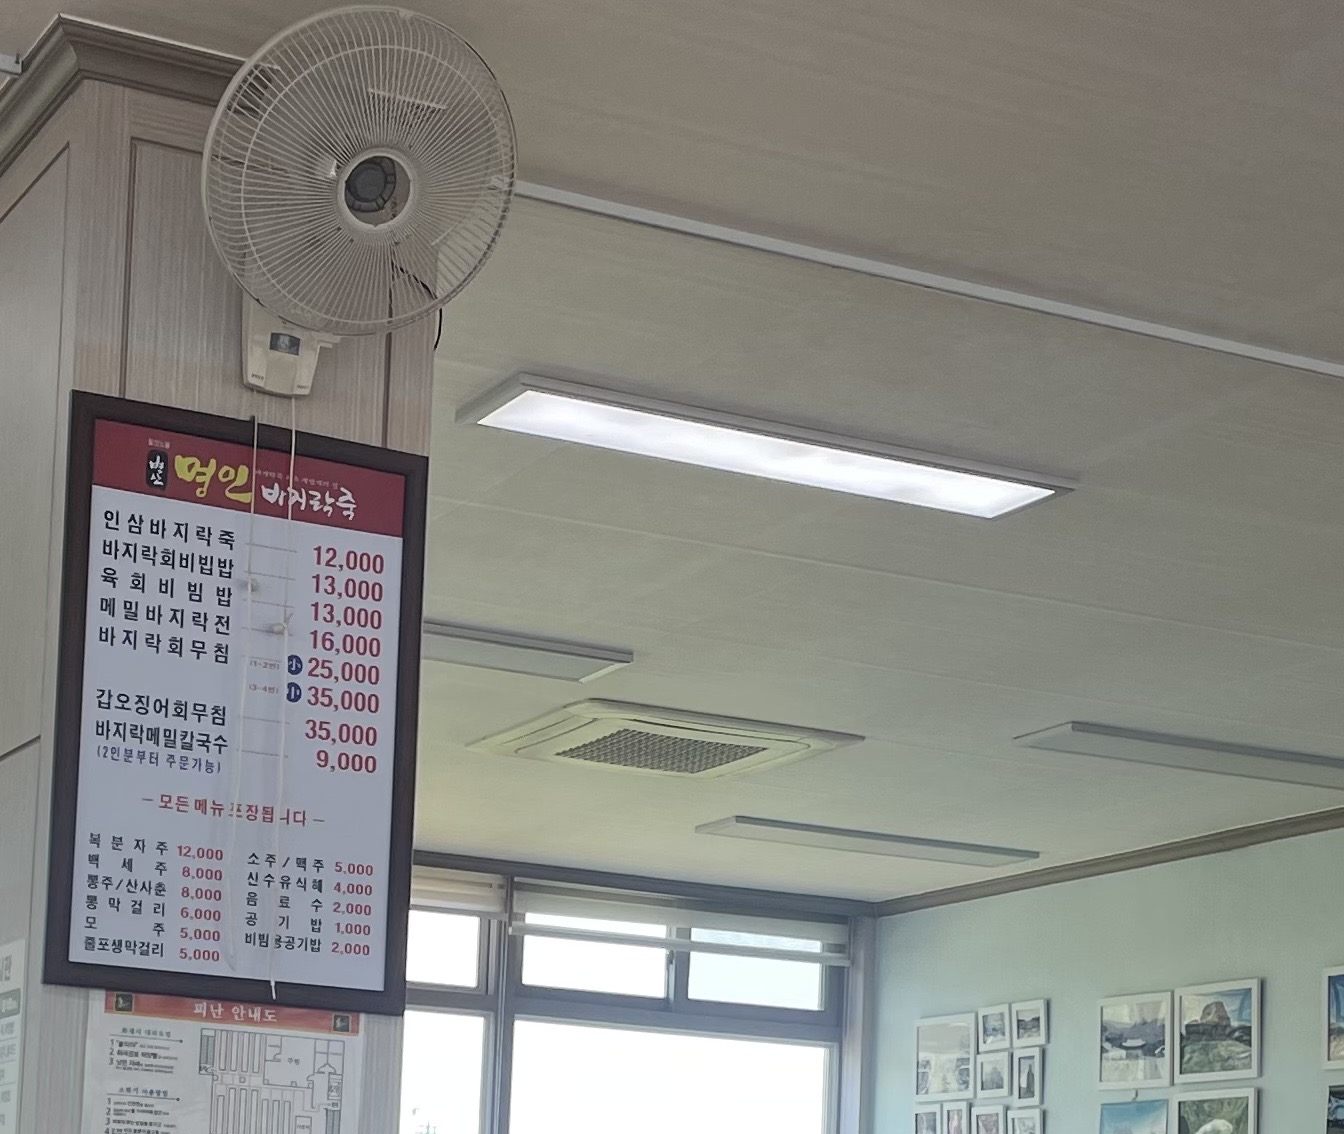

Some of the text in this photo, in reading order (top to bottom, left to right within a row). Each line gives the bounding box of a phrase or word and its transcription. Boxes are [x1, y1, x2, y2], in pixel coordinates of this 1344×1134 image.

[174, 454, 253, 503] 명인
[261, 482, 357, 520] 바지락죽
[104, 510, 235, 550] 인삼바지락죽
[313, 546, 384, 574] 12,000
[101, 567, 232, 607] 육회비빔밥
[312, 574, 383, 602] 13,000
[100, 597, 230, 635] 메밀바지락전
[310, 602, 382, 629] 13,000
[99, 626, 229, 664] 바지락회무침
[309, 630, 381, 658] 16,000
[308, 657, 380, 685] 25,000
[96, 688, 226, 726] 갑오징어회무침
[307, 686, 379, 713] 35,000
[95, 720, 228, 754] 바지락메밀칼국수
[305, 719, 377, 747] 35,000
[316, 750, 377, 773] 9,000
[159, 794, 189, 813] 모든
[194, 798, 224, 817] 메뉴
[89, 832, 168, 856] 복분자주
[177, 845, 223, 861] 12,000
[182, 866, 223, 881] 8,000
[334, 861, 374, 876] 5,000
[181, 886, 222, 901] 8,000
[334, 882, 373, 896] 4,000
[246, 891, 323, 913] 음료수
[333, 901, 372, 916] 2,000
[180, 907, 221, 922] 6,000
[245, 911, 322, 933] 공기밥
[180, 927, 221, 942] 5,000
[335, 922, 371, 936] 1,000
[179, 947, 220, 962] 5,000
[331, 941, 370, 956] 2,000
[192, 1002, 278, 1023] 피난 안내도
